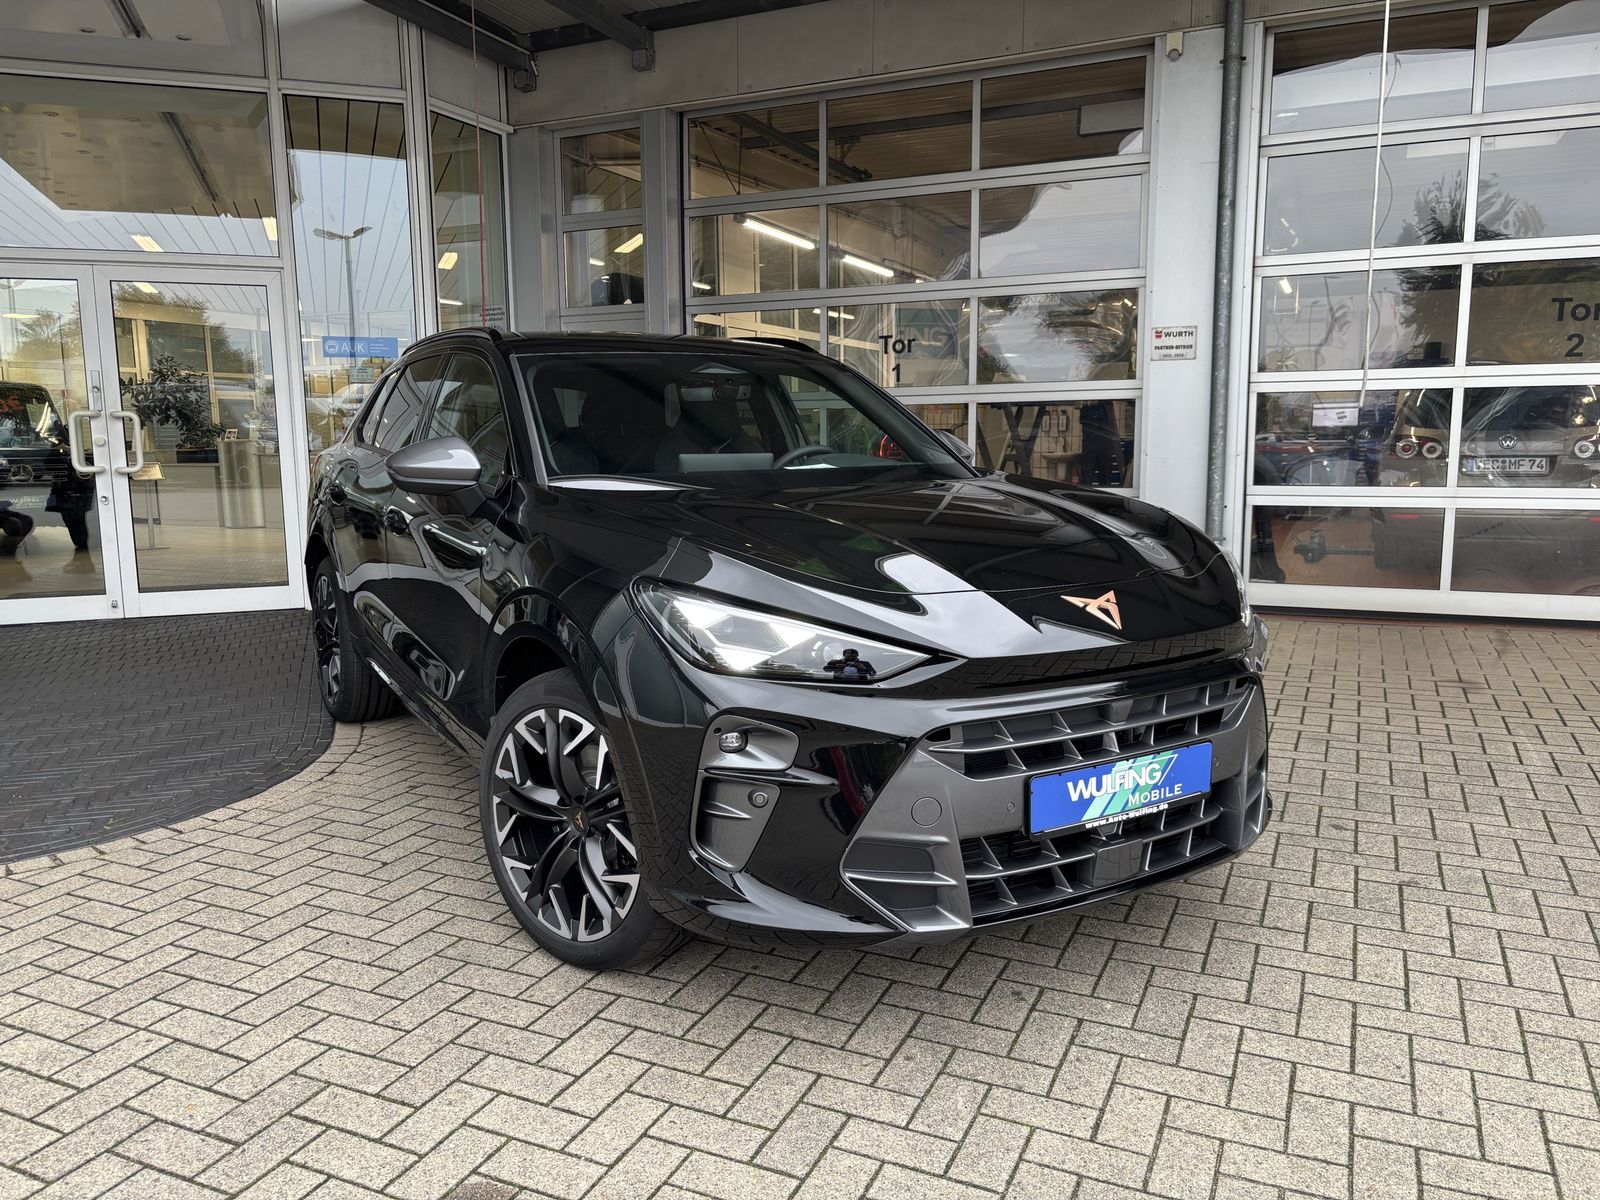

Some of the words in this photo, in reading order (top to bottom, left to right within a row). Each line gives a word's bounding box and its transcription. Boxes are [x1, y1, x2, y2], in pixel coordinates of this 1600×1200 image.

[879, 334, 916, 355] Tor
[1565, 333, 1585, 357] 2
[892, 363, 901, 382] 1
[1508, 459, 1526, 470] MF
[1528, 459, 1545, 470] 74
[1067, 763, 1162, 801] WULFING
[1128, 783, 1183, 807] MOBILE
[1085, 803, 1169, 829] www.Auto-Wulfing.de
